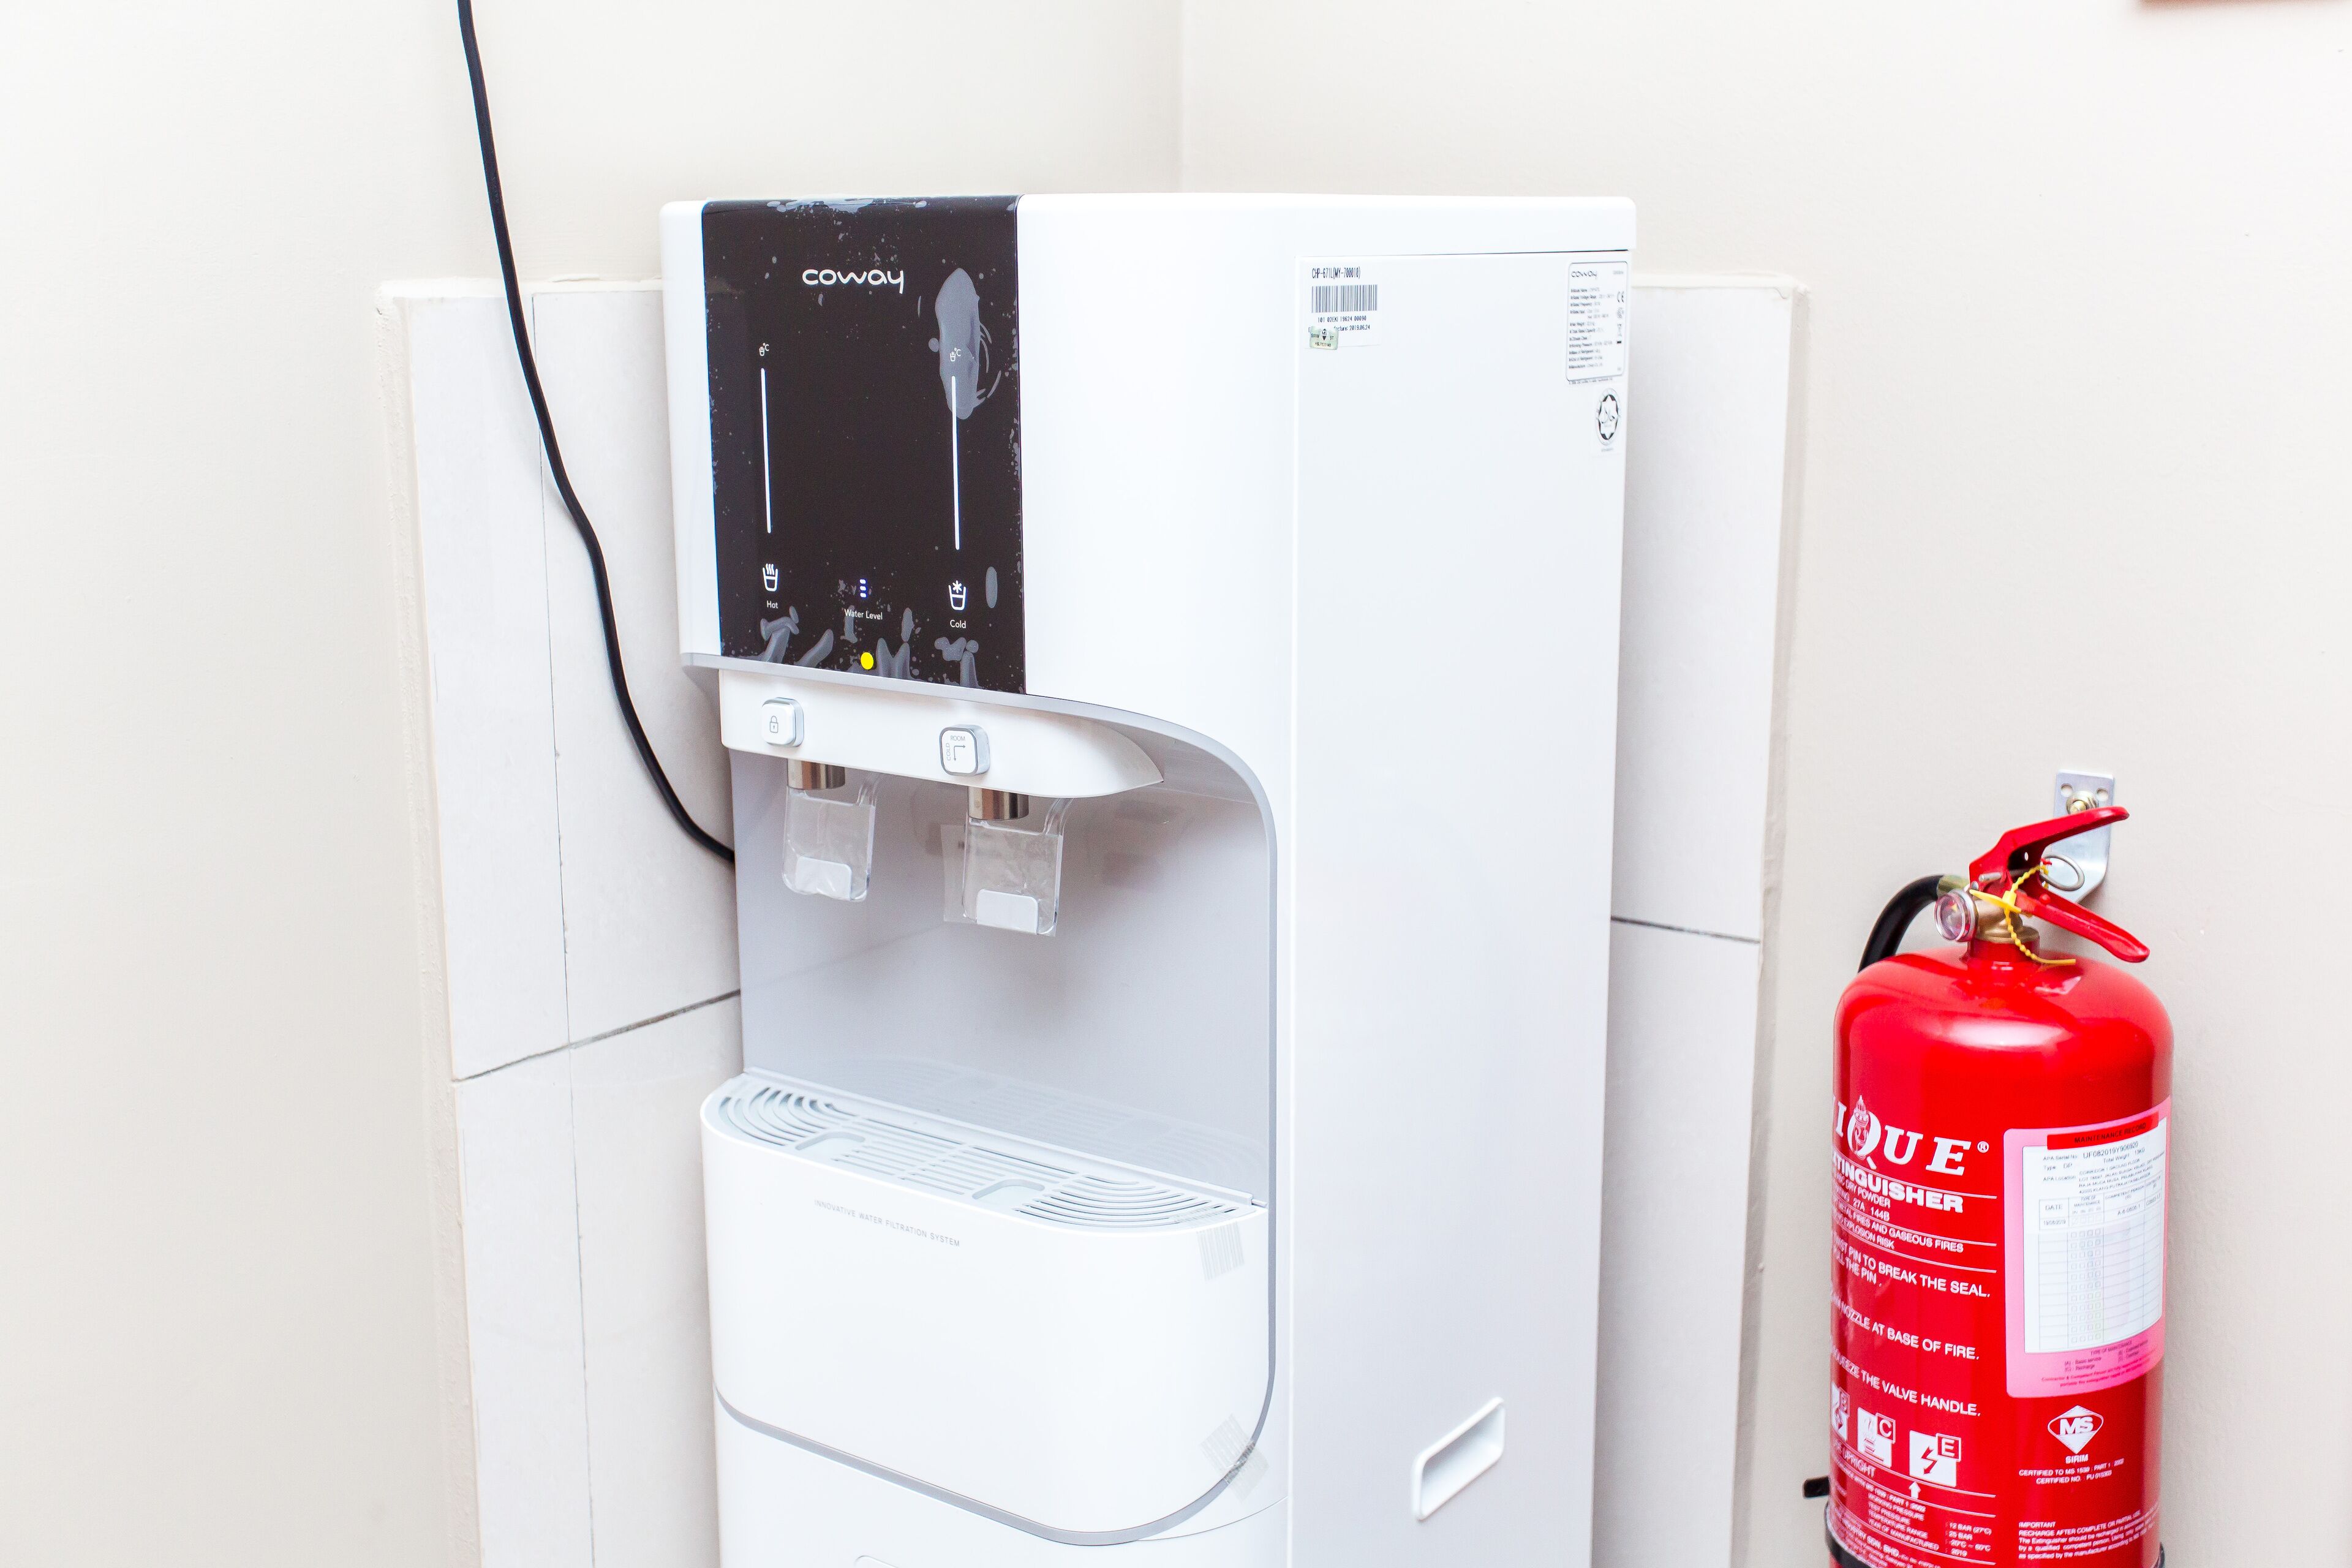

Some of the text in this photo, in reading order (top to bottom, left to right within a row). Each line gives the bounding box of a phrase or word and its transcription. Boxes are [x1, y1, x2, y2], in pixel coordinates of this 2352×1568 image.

[802, 268, 904, 294] coway
[766, 600, 778, 609] Hot
[844, 609, 883, 620] Water Level
[949, 619, 967, 629] Cold
[1833, 1094, 1972, 1175] IQUE
[2074, 1123, 2146, 1144] MAINTENANCE RECORD
[1857, 1186, 1891, 1208] POWDER
[1853, 1197, 1890, 1221] 27A 144B
[814, 1199, 960, 1247] INNOVATIVE WATER FILTRATION SYSTEM
[1853, 1211, 1871, 1228] FIRES
[1871, 1221, 1888, 1235] AND
[1888, 1228, 1933, 1248] GASEOUS
[1934, 1239, 1964, 1253] FIRES
[1876, 1235, 1895, 1250] RISK
[1845, 1256, 1860, 1276] THE
[1849, 1245, 1991, 1298] PIN TO BREAK THE SEAL.
[1841, 1301, 1870, 1330] NOZZLE
[1872, 1322, 1885, 1336] AT
[1887, 1327, 1919, 1348] BASE
[1922, 1338, 1942, 1353] OF
[1945, 1343, 1980, 1360] FIRE.
[1861, 1369, 1880, 1390] THE
[1882, 1381, 1918, 1403] VALVE
[1921, 1394, 1981, 1417] HANDLE.
[1879, 1419, 1892, 1438] C
[2060, 1416, 2094, 1434] MS
[1941, 1438, 1955, 1457] E
[1842, 1450, 1876, 1477] UPRIGHT
[2065, 1454, 2089, 1464] SIRIM
[1881, 1507, 1910, 1525] PRESSURE
[1892, 1502, 1925, 1521] PRESSURE
[1869, 1510, 1906, 1531] TEMPERATURE
[1906, 1524, 1928, 1539] RANGE
[1882, 1525, 1890, 1533] OF
[1958, 1523, 1972, 1532] BAR
[2076, 1523, 2107, 1534] COMPLETE
[1958, 1532, 1973, 1540] BAR
[1951, 1548, 1967, 1557] 2019
